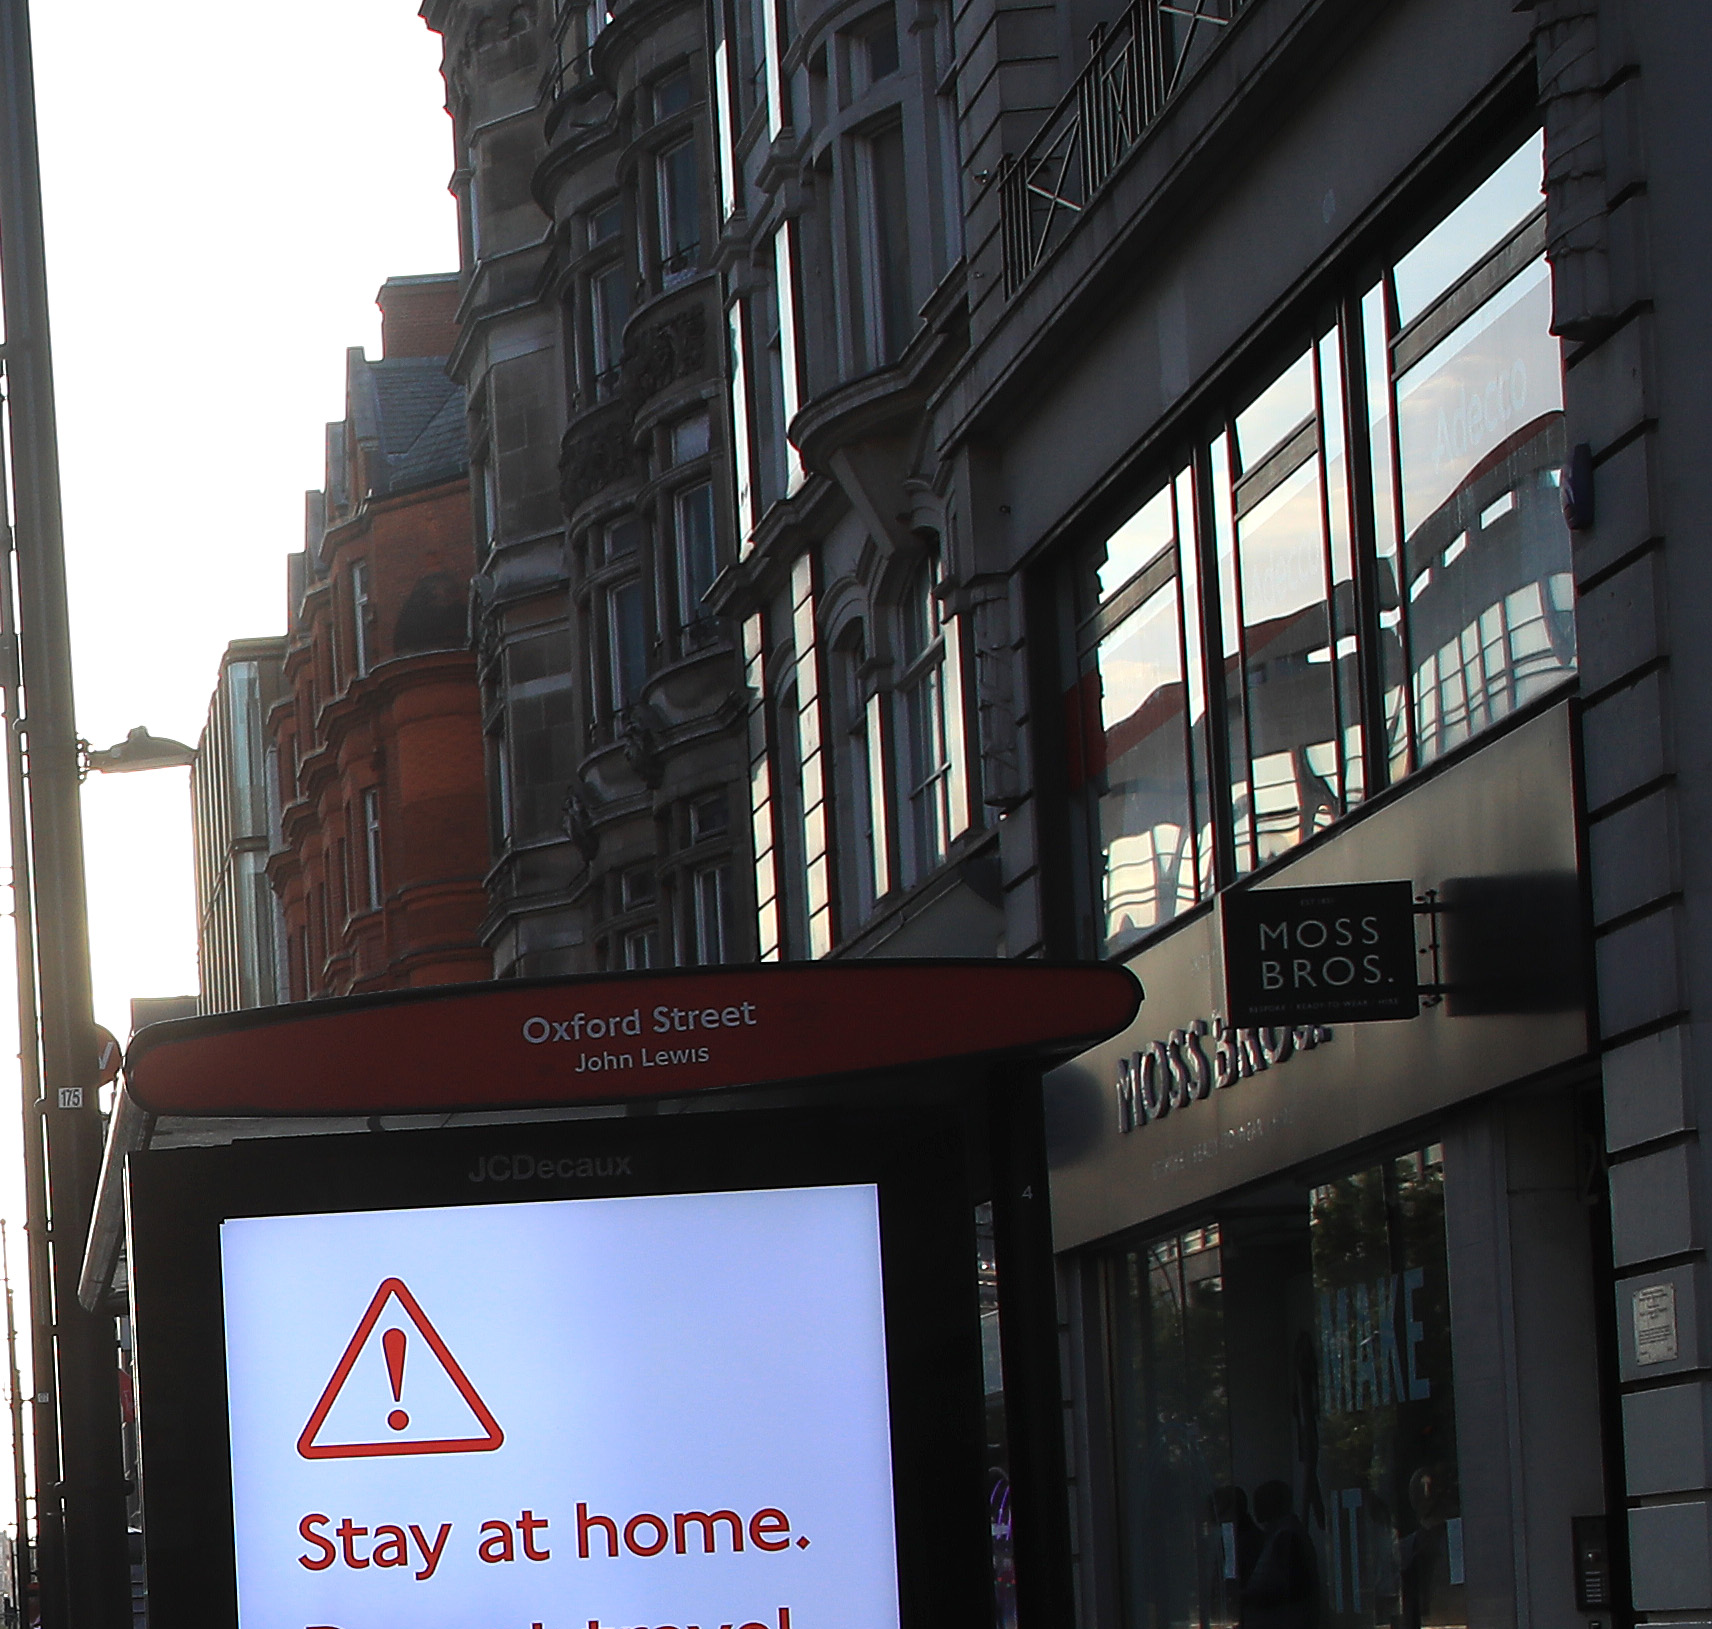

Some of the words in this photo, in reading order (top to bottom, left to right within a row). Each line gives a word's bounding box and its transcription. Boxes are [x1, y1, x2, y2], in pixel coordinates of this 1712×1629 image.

[1258, 916, 1380, 951] MOSS
[1261, 954, 1395, 990] BROS.
[522, 1008, 642, 1044] Oxford
[652, 1001, 757, 1034] Street
[575, 1051, 634, 1073] John
[641, 1047, 711, 1067] Lewis
[1116, 1019, 1211, 1134] MOSS
[60, 1089, 81, 1108] 175
[467, 1153, 634, 1183] JCDecaux
[1319, 1266, 1431, 1416] MAKE
[297, 1512, 452, 1581] Stay
[478, 1510, 551, 1564] at
[576, 1502, 812, 1559] home.
[1330, 1487, 1362, 1614] IT
